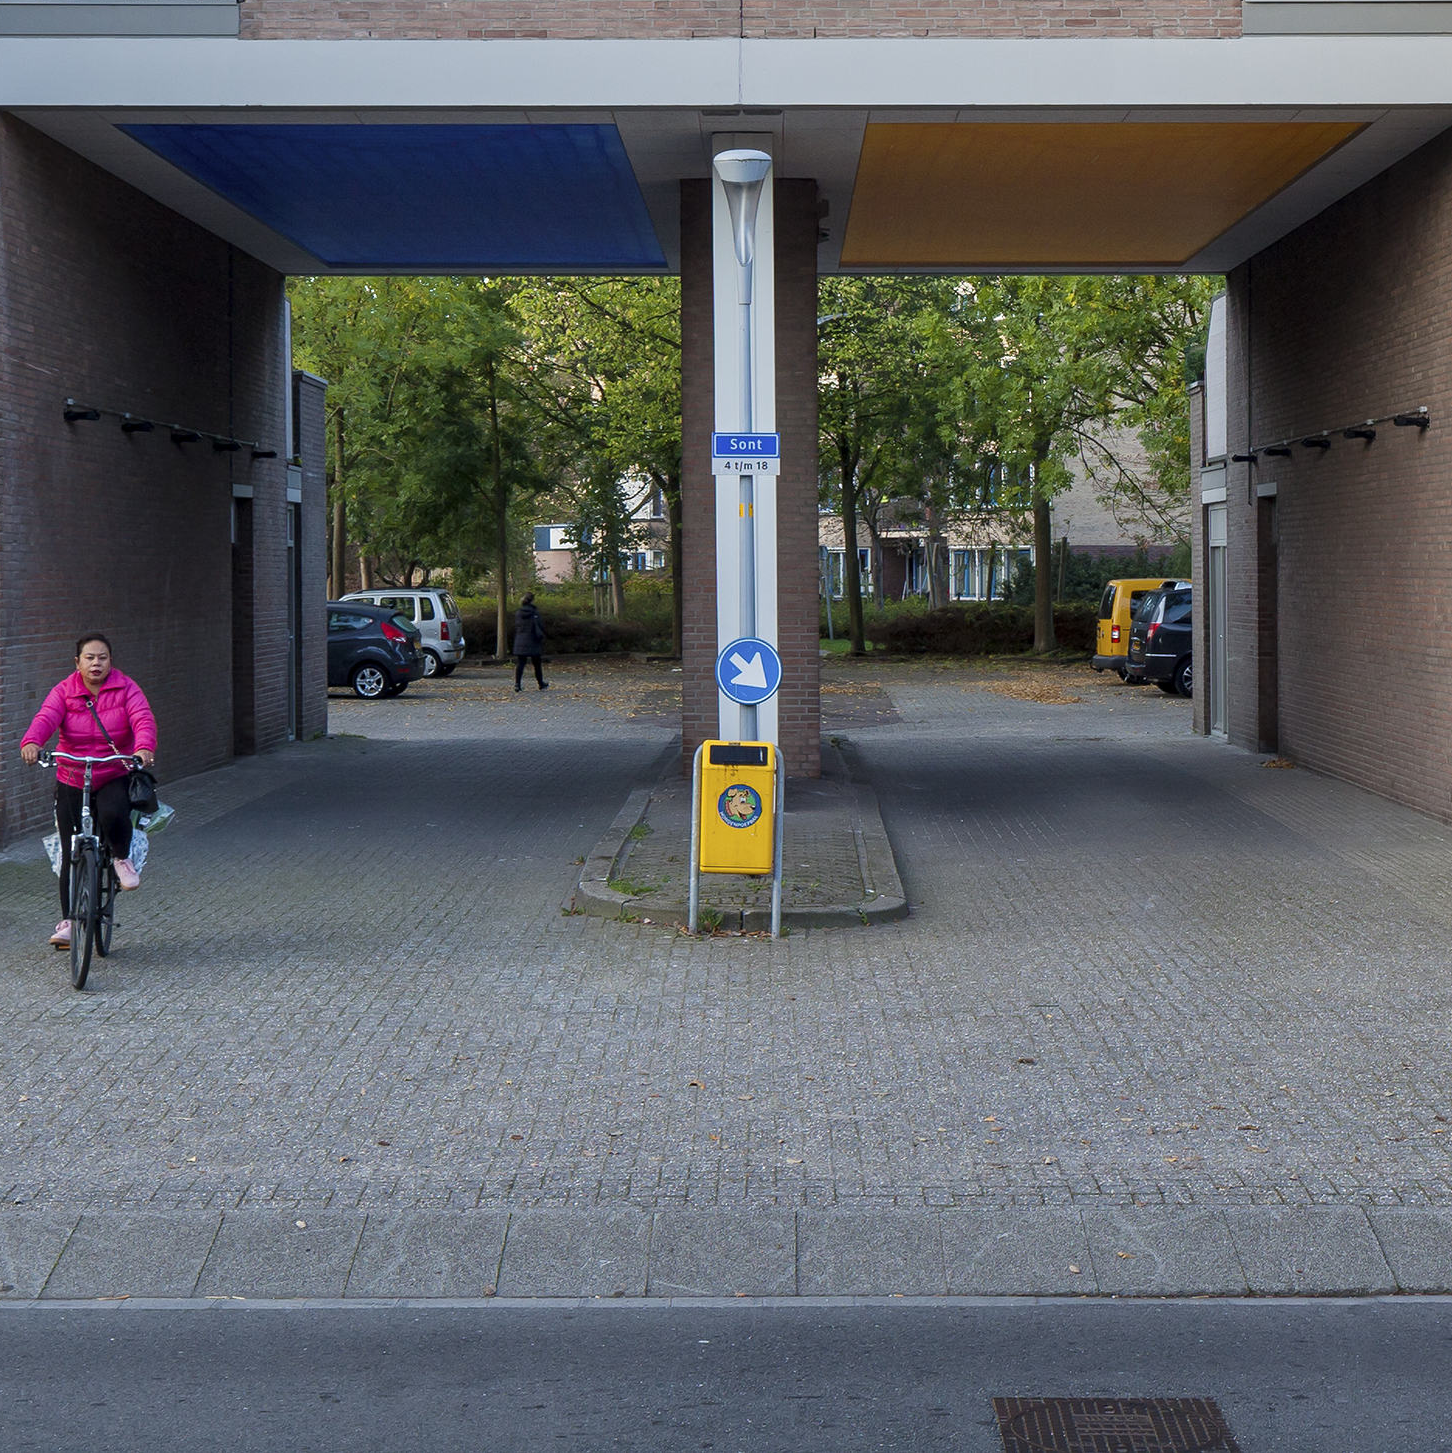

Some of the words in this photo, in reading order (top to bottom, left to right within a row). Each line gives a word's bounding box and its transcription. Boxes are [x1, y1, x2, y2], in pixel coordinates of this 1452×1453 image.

[730, 438, 762, 450] Sont
[724, 461, 731, 469] 4
[735, 461, 753, 472] t/m
[756, 461, 768, 470] 18
